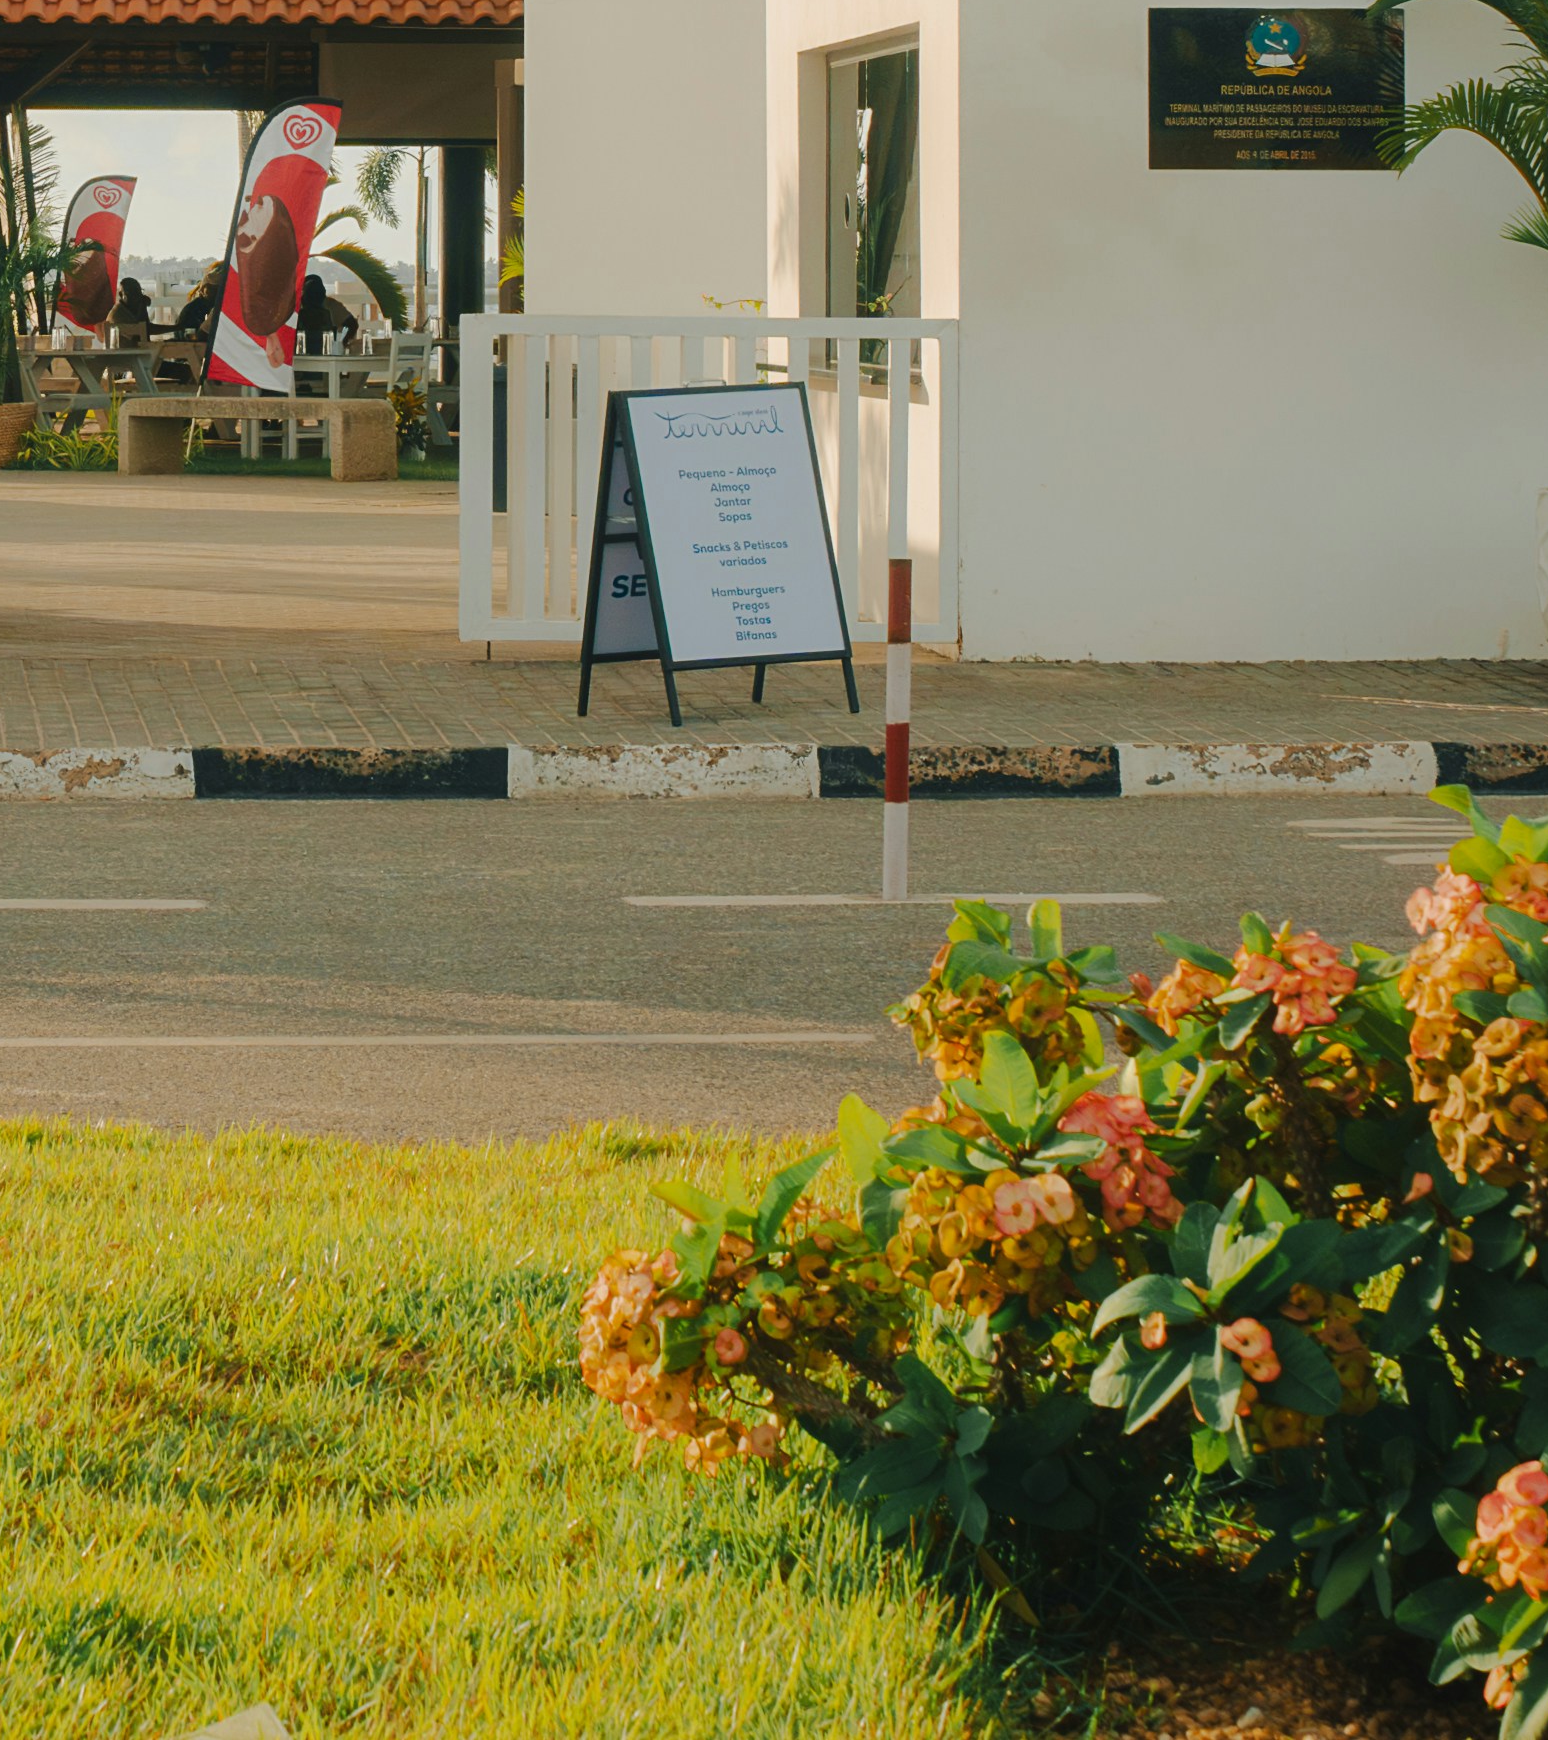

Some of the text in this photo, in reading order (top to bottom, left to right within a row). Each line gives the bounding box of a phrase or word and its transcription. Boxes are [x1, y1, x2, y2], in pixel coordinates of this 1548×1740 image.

[1277, 85, 1290, 95] DE
[1292, 85, 1332, 96] ANGOLA
[1170, 104, 1202, 113] TERMINAL
[1235, 104, 1245, 113] DE
[1246, 104, 1291, 113] PASSAGEIROS
[678, 469, 726, 481] Pequeno
[736, 466, 777, 478] Almoço
[710, 482, 751, 494] Almoço
[714, 497, 752, 508] Jantar
[718, 511, 752, 523] Sopas
[692, 539, 789, 554] Snacks & Petiscos
[719, 556, 767, 567] variados
[711, 585, 786, 598] Hamburguers
[732, 601, 770, 613] Pregos
[736, 615, 771, 626] Tostas
[736, 630, 777, 641] Bifanas
